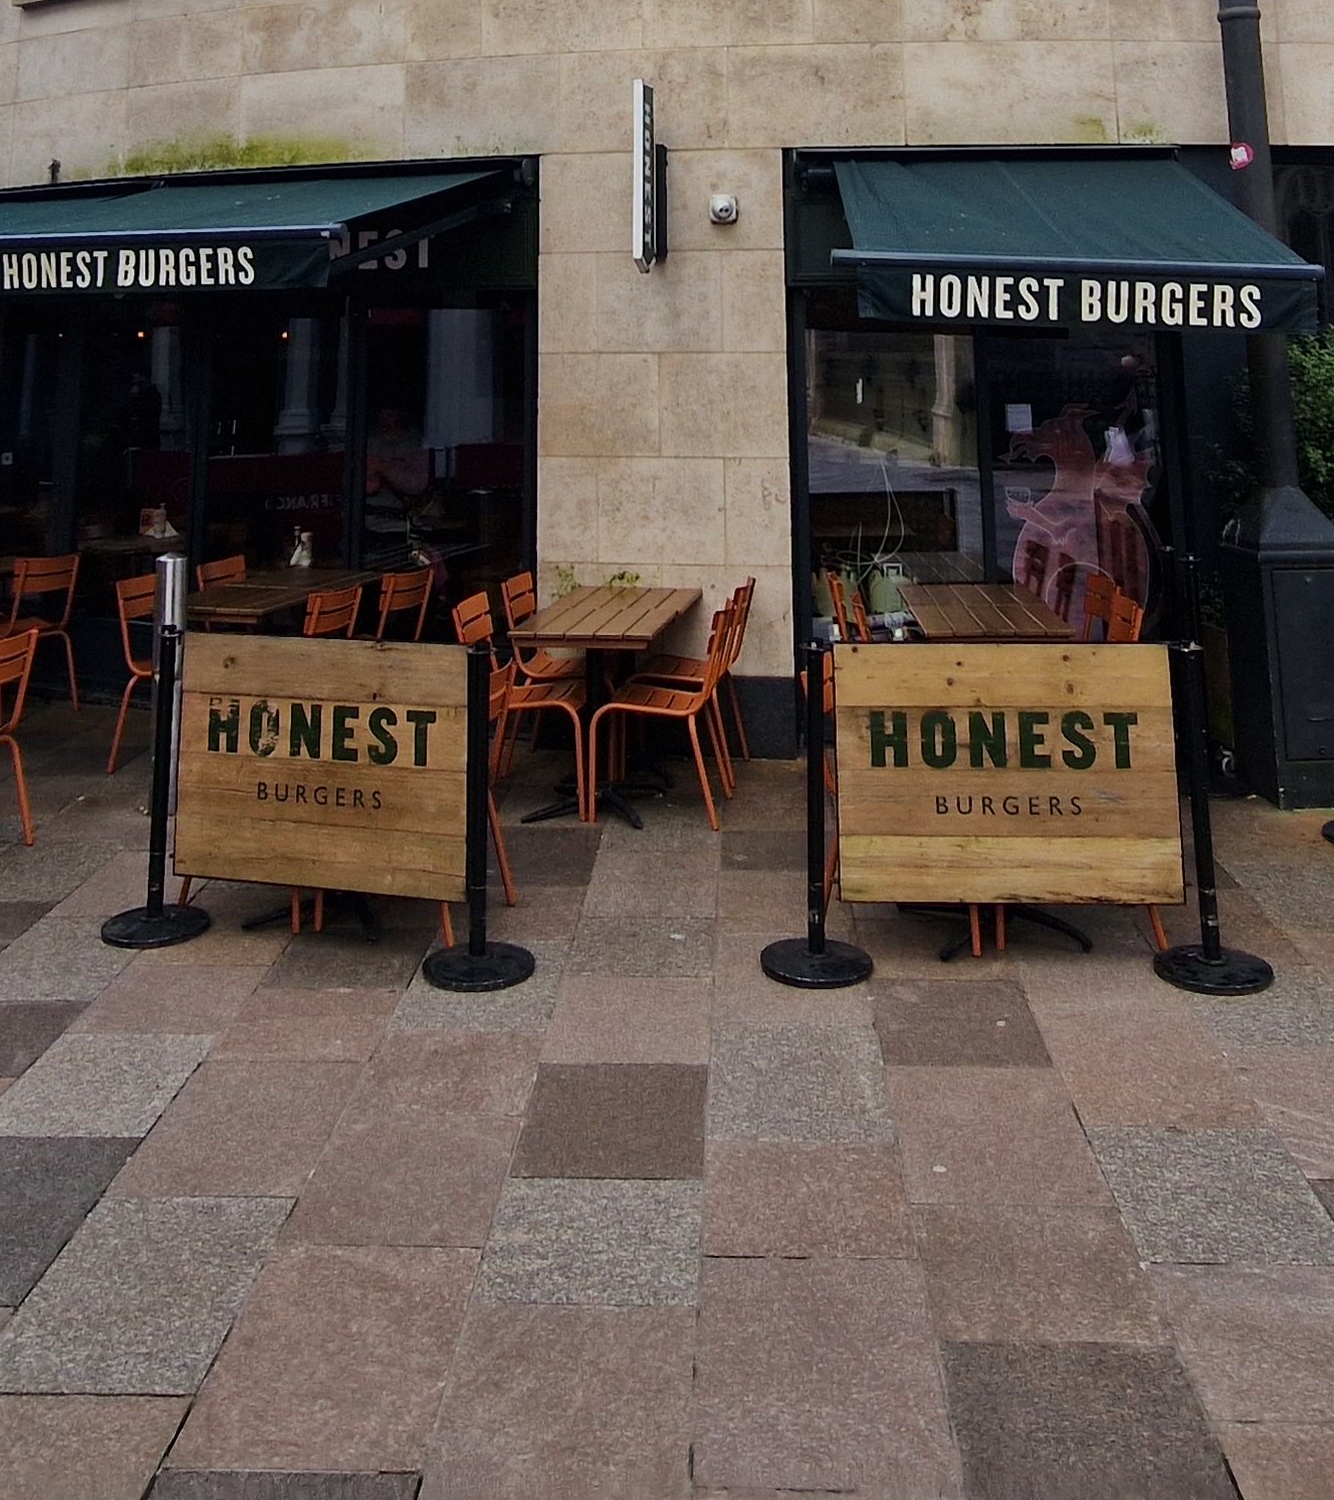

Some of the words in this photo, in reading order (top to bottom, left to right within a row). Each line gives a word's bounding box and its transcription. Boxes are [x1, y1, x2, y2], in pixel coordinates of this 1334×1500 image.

[3, 251, 108, 290] HONEST
[117, 246, 255, 287] BURGERS
[912, 274, 1065, 321] HONEST
[1081, 279, 1262, 329] BURGERS
[207, 697, 437, 767] HONEST
[869, 711, 1139, 769] HONEST
[257, 782, 382, 810] BURGERS
[936, 796, 1083, 816] BURGERS
